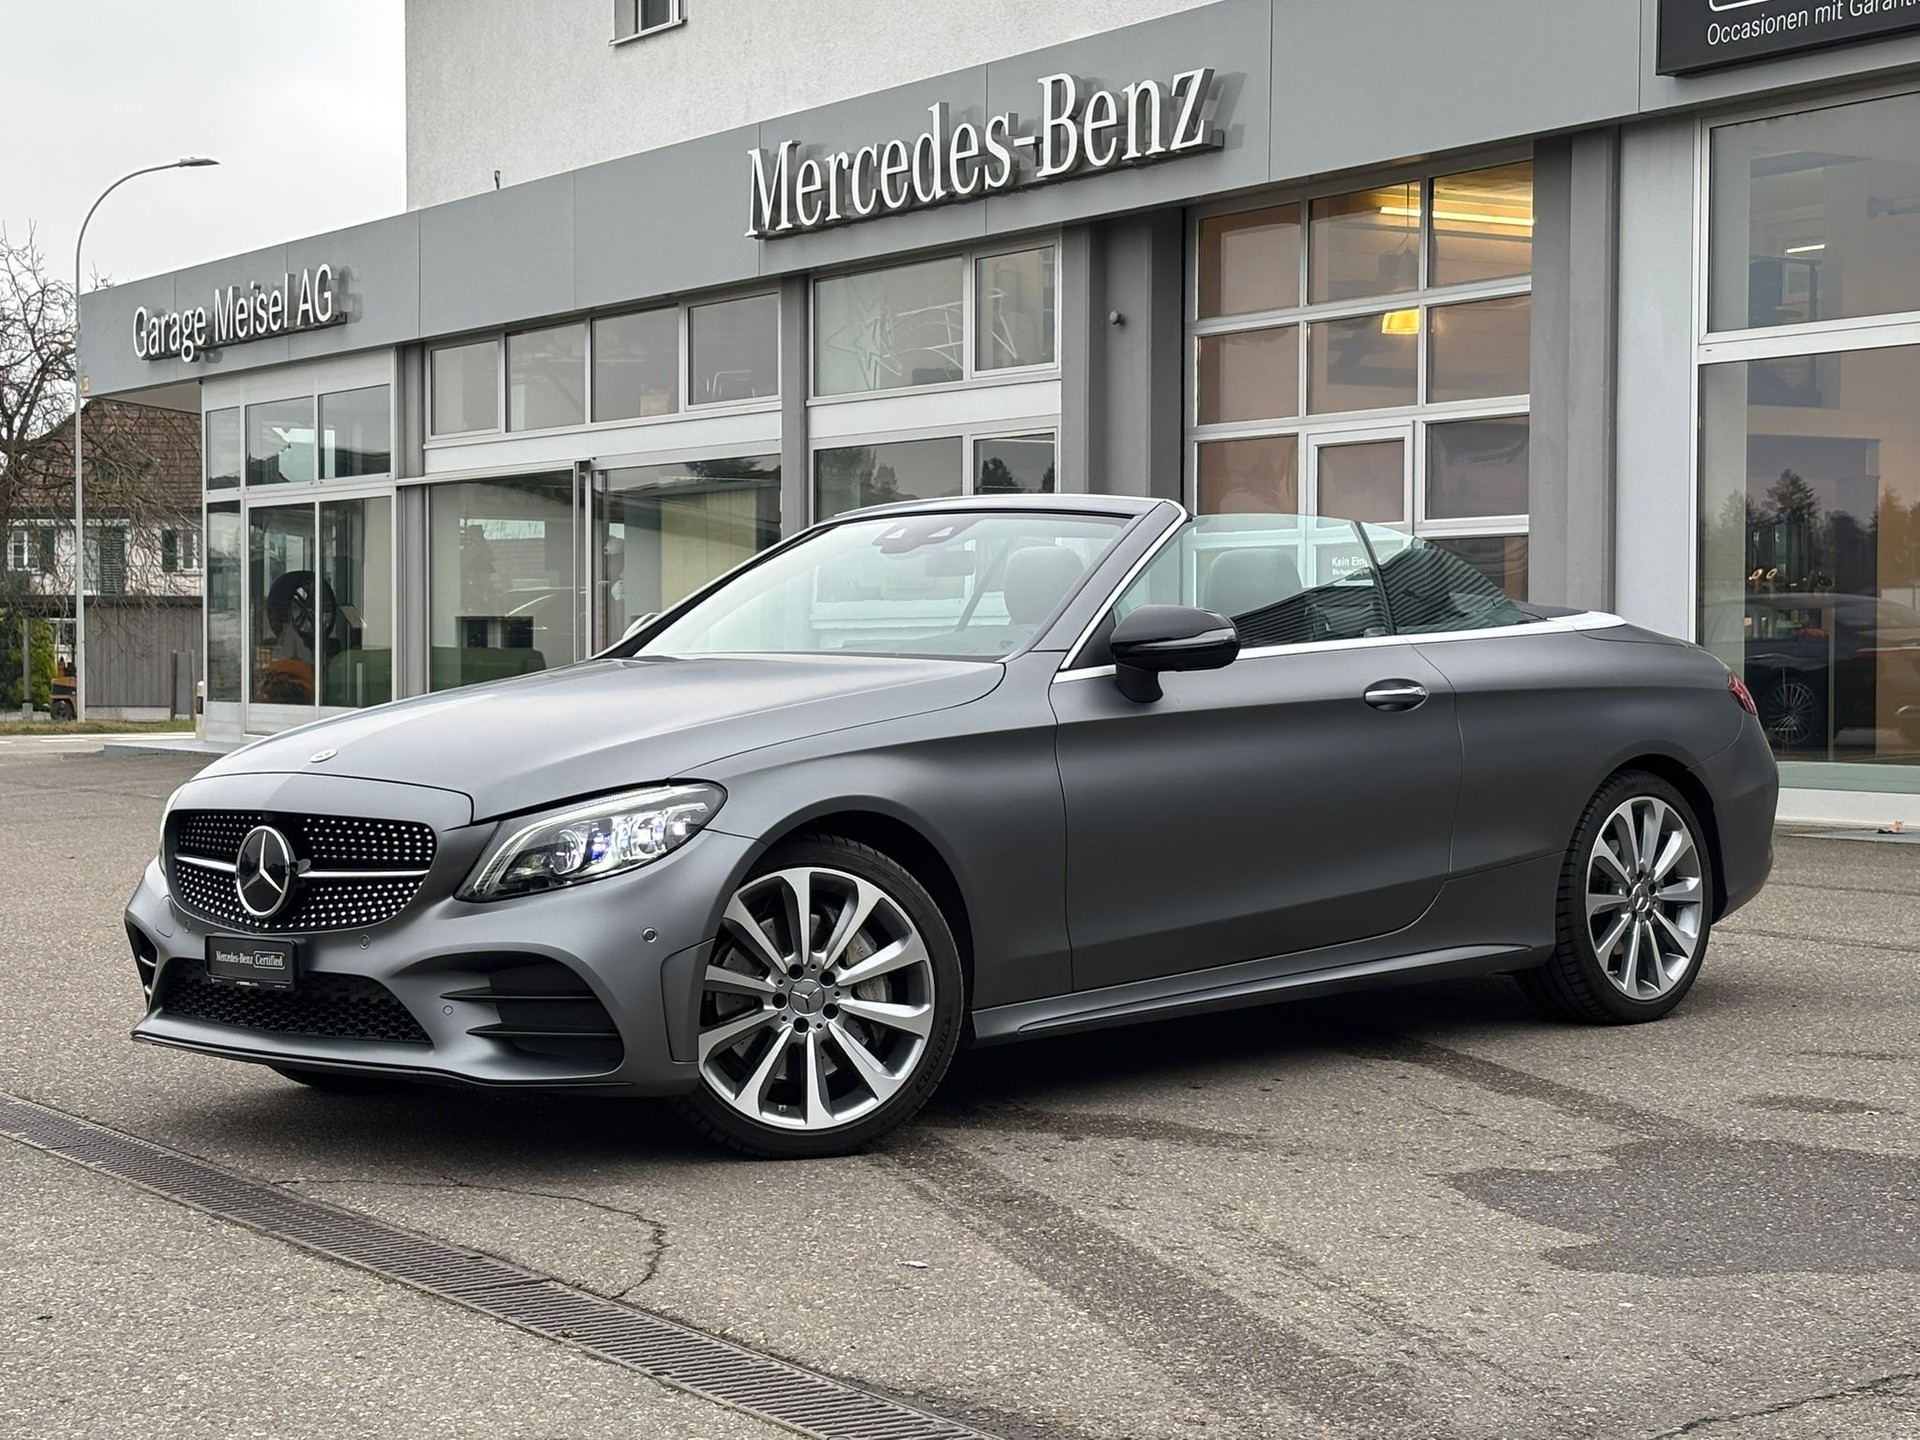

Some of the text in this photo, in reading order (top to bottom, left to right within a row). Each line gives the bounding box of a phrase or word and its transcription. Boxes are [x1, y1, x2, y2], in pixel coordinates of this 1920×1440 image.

[1707, 10, 1808, 46] Occasionen
[1815, 1, 1843, 25] mit
[745, 68, 1215, 238] Mercedes-Benz
[133, 263, 333, 363] Garage Meisel AG
[1331, 556, 1350, 567] Kein
[215, 950, 283, 967] Mercedes-Benz Certified
